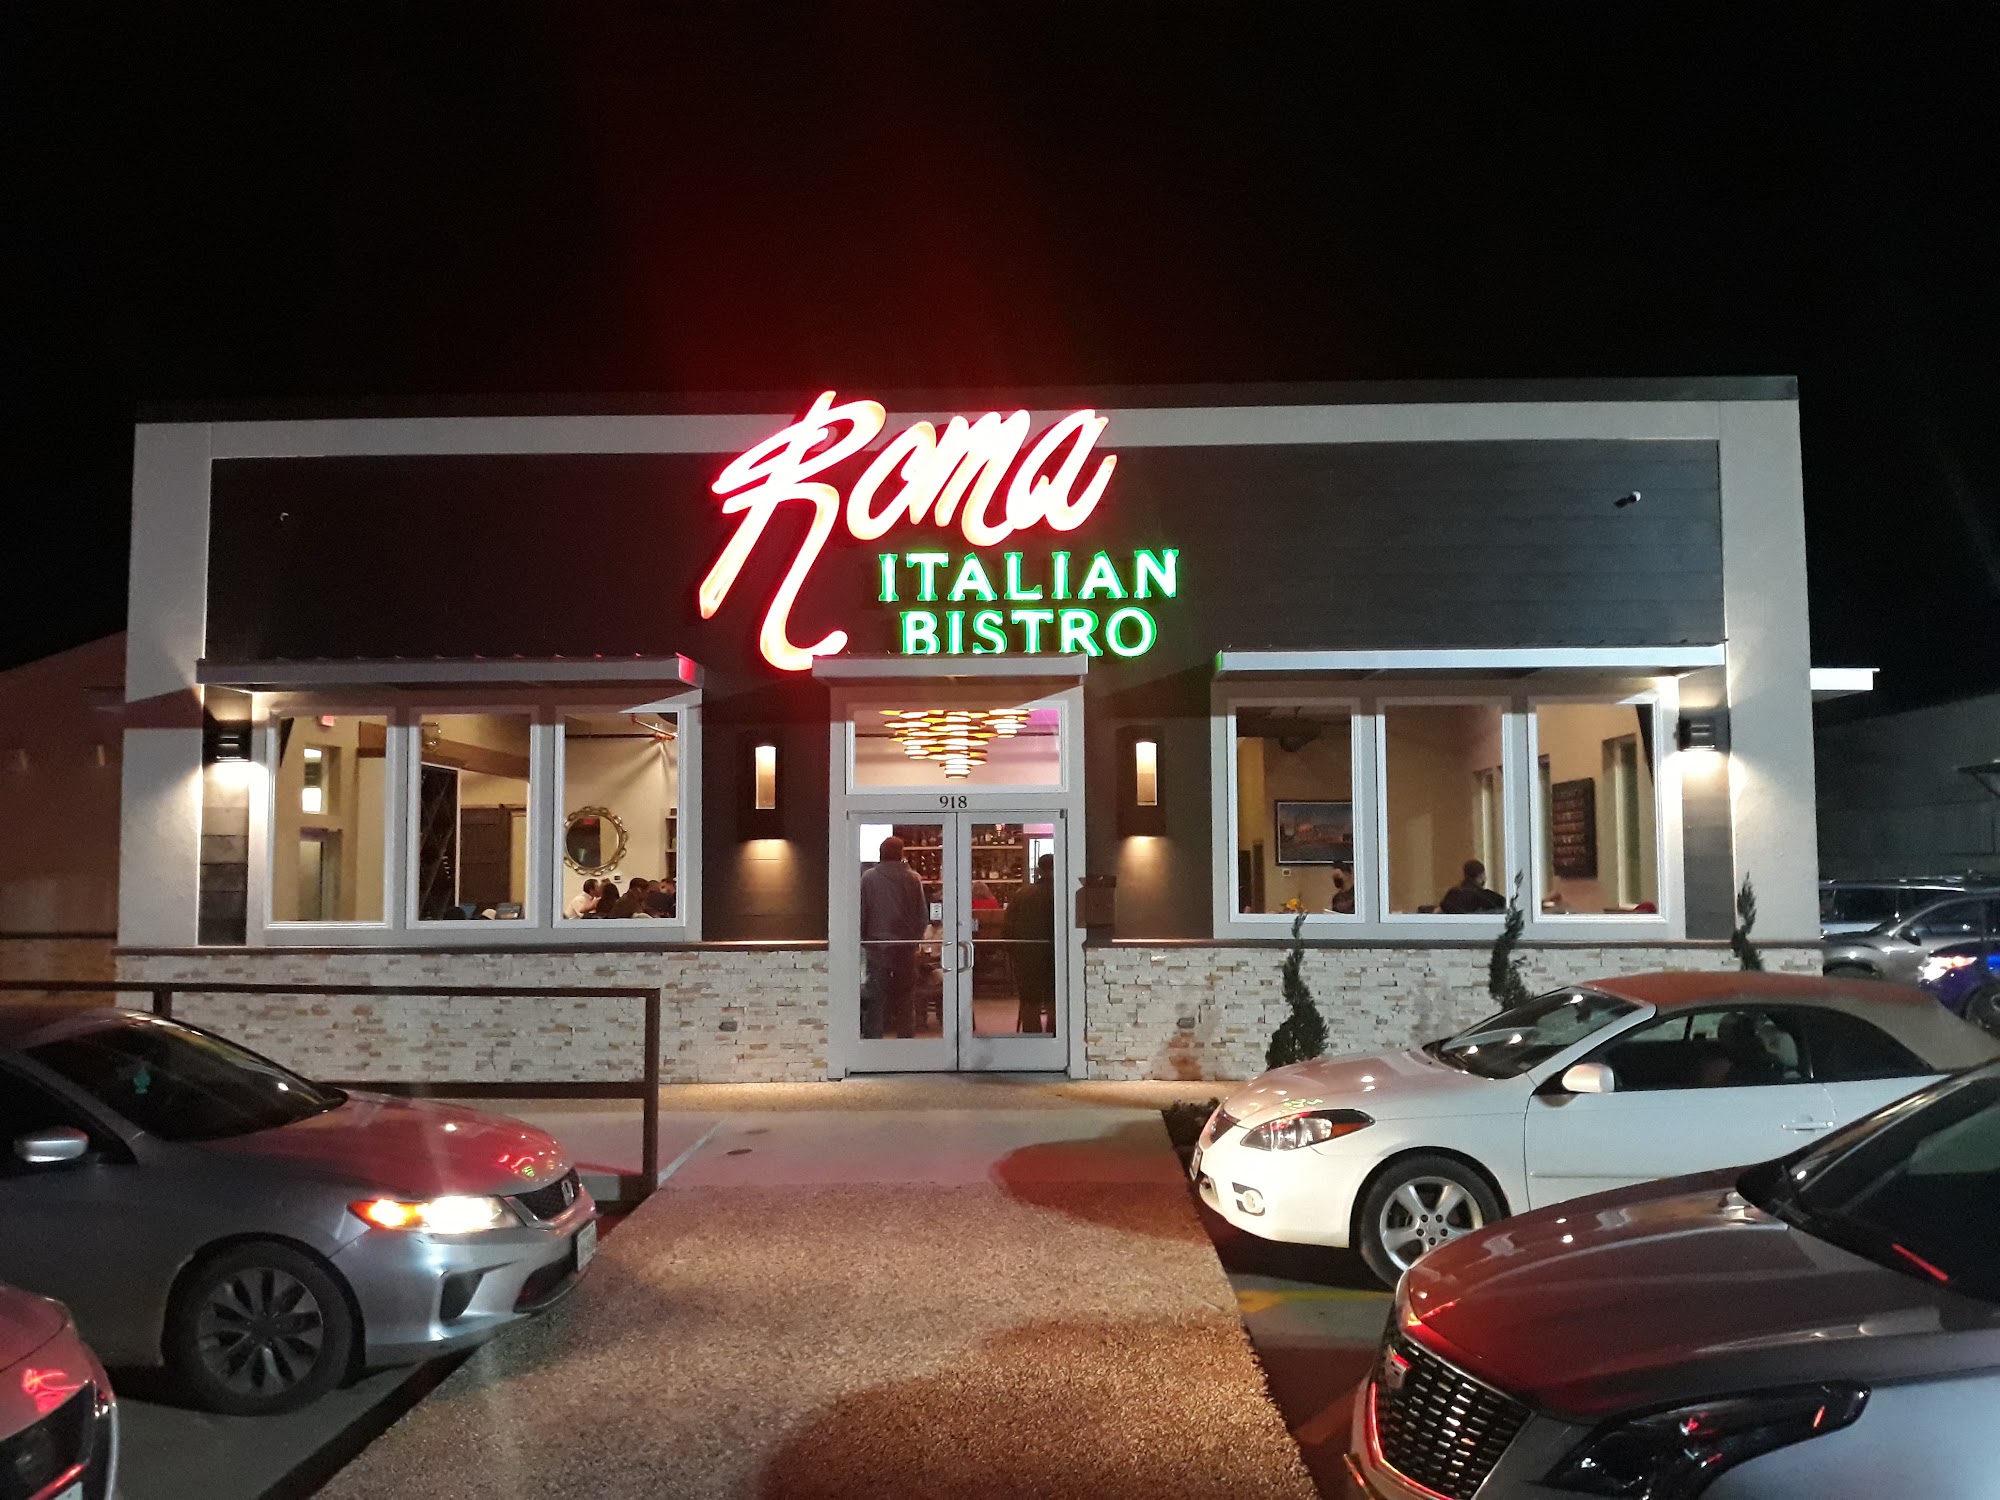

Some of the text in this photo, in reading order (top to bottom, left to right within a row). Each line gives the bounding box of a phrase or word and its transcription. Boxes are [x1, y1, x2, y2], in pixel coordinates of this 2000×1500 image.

[699, 391, 1117, 671] Roma
[877, 549, 1180, 602] ITALIAN
[900, 607, 1157, 658] BISTRO
[939, 795, 968, 809] 918
